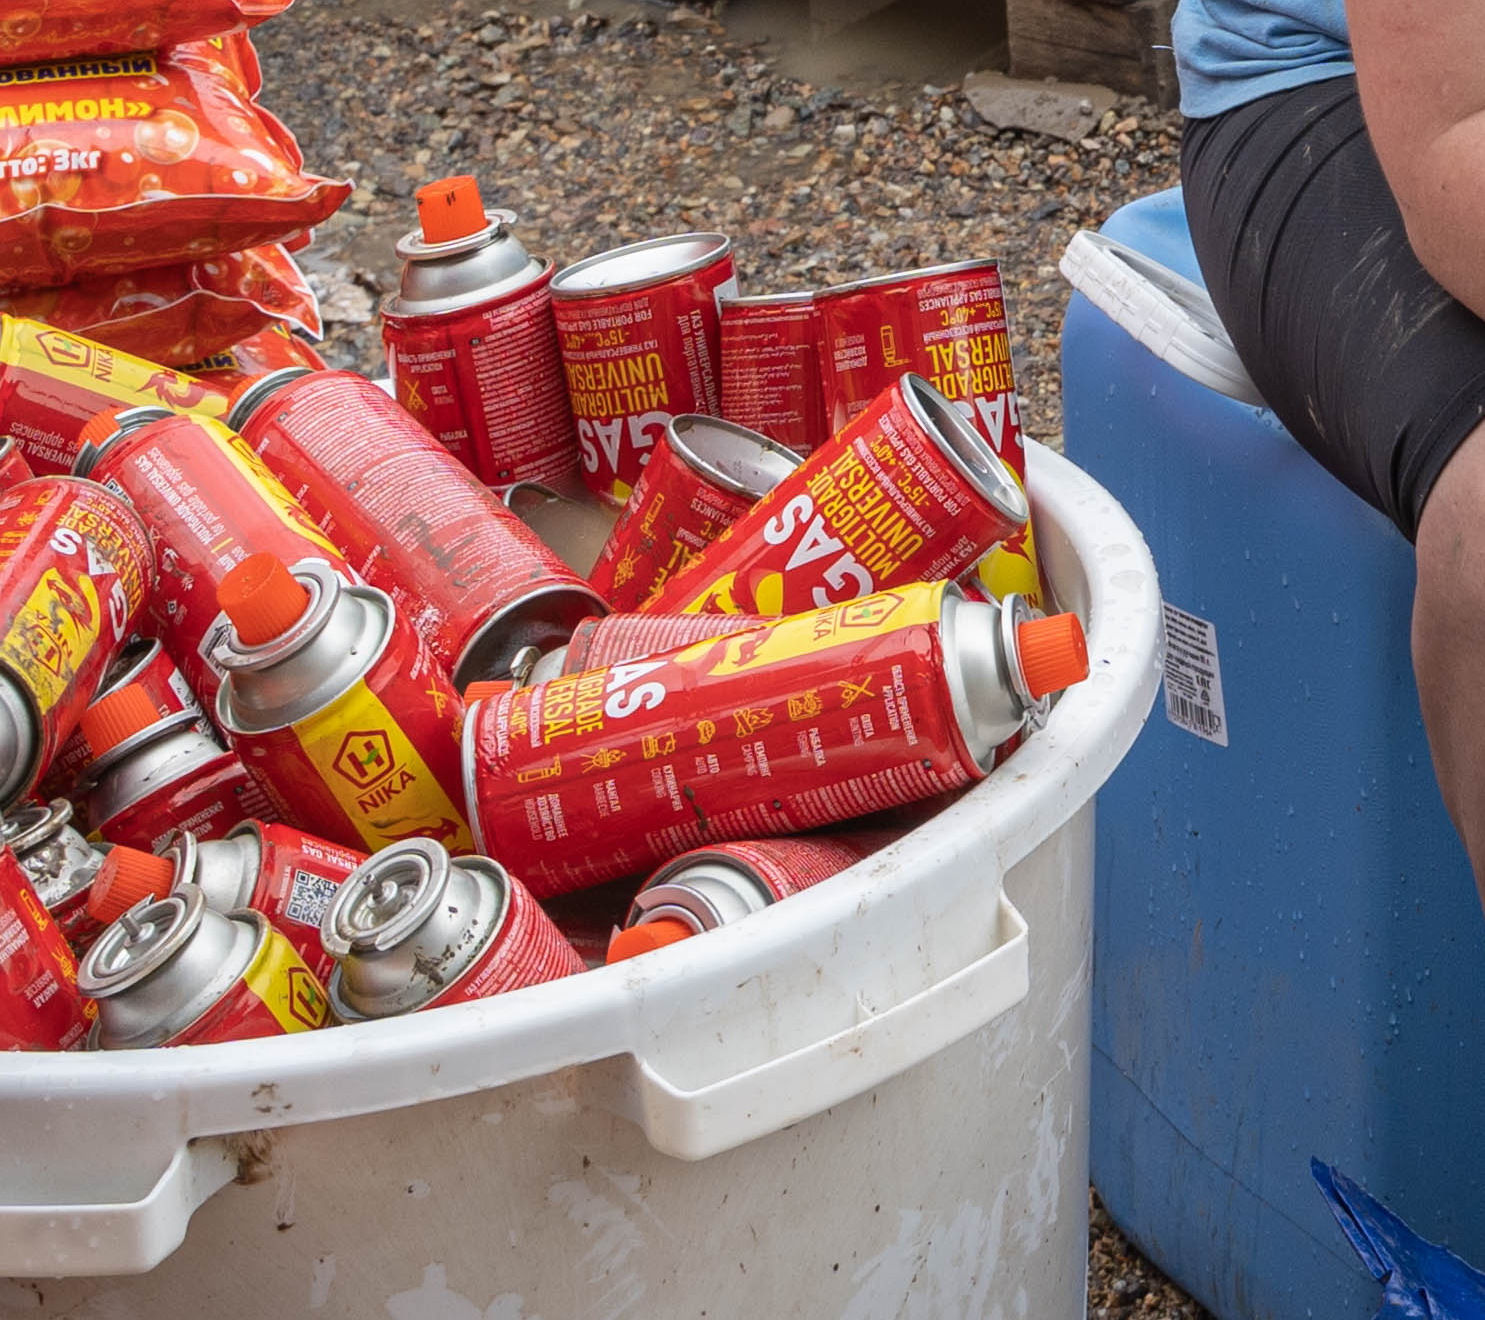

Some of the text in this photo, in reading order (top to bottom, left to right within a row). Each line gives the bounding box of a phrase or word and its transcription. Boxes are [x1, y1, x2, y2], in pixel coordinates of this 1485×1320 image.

[54, 150, 101, 171] 3кг
[24, 441, 74, 467] NIVERSAL
[902, 445, 916, 465] GAS
[832, 446, 923, 559] UNIVERSAL
[915, 462, 950, 507] PORTABLE
[806, 466, 901, 580] MULTIGRADE
[943, 500, 962, 517] FOR
[920, 520, 935, 539] ГАЗ
[763, 494, 874, 607] GAS
[809, 728, 826, 767] РЫБАЛКА
[357, 770, 416, 814] NIKA
[605, 779, 622, 812] МАНГАЛ
